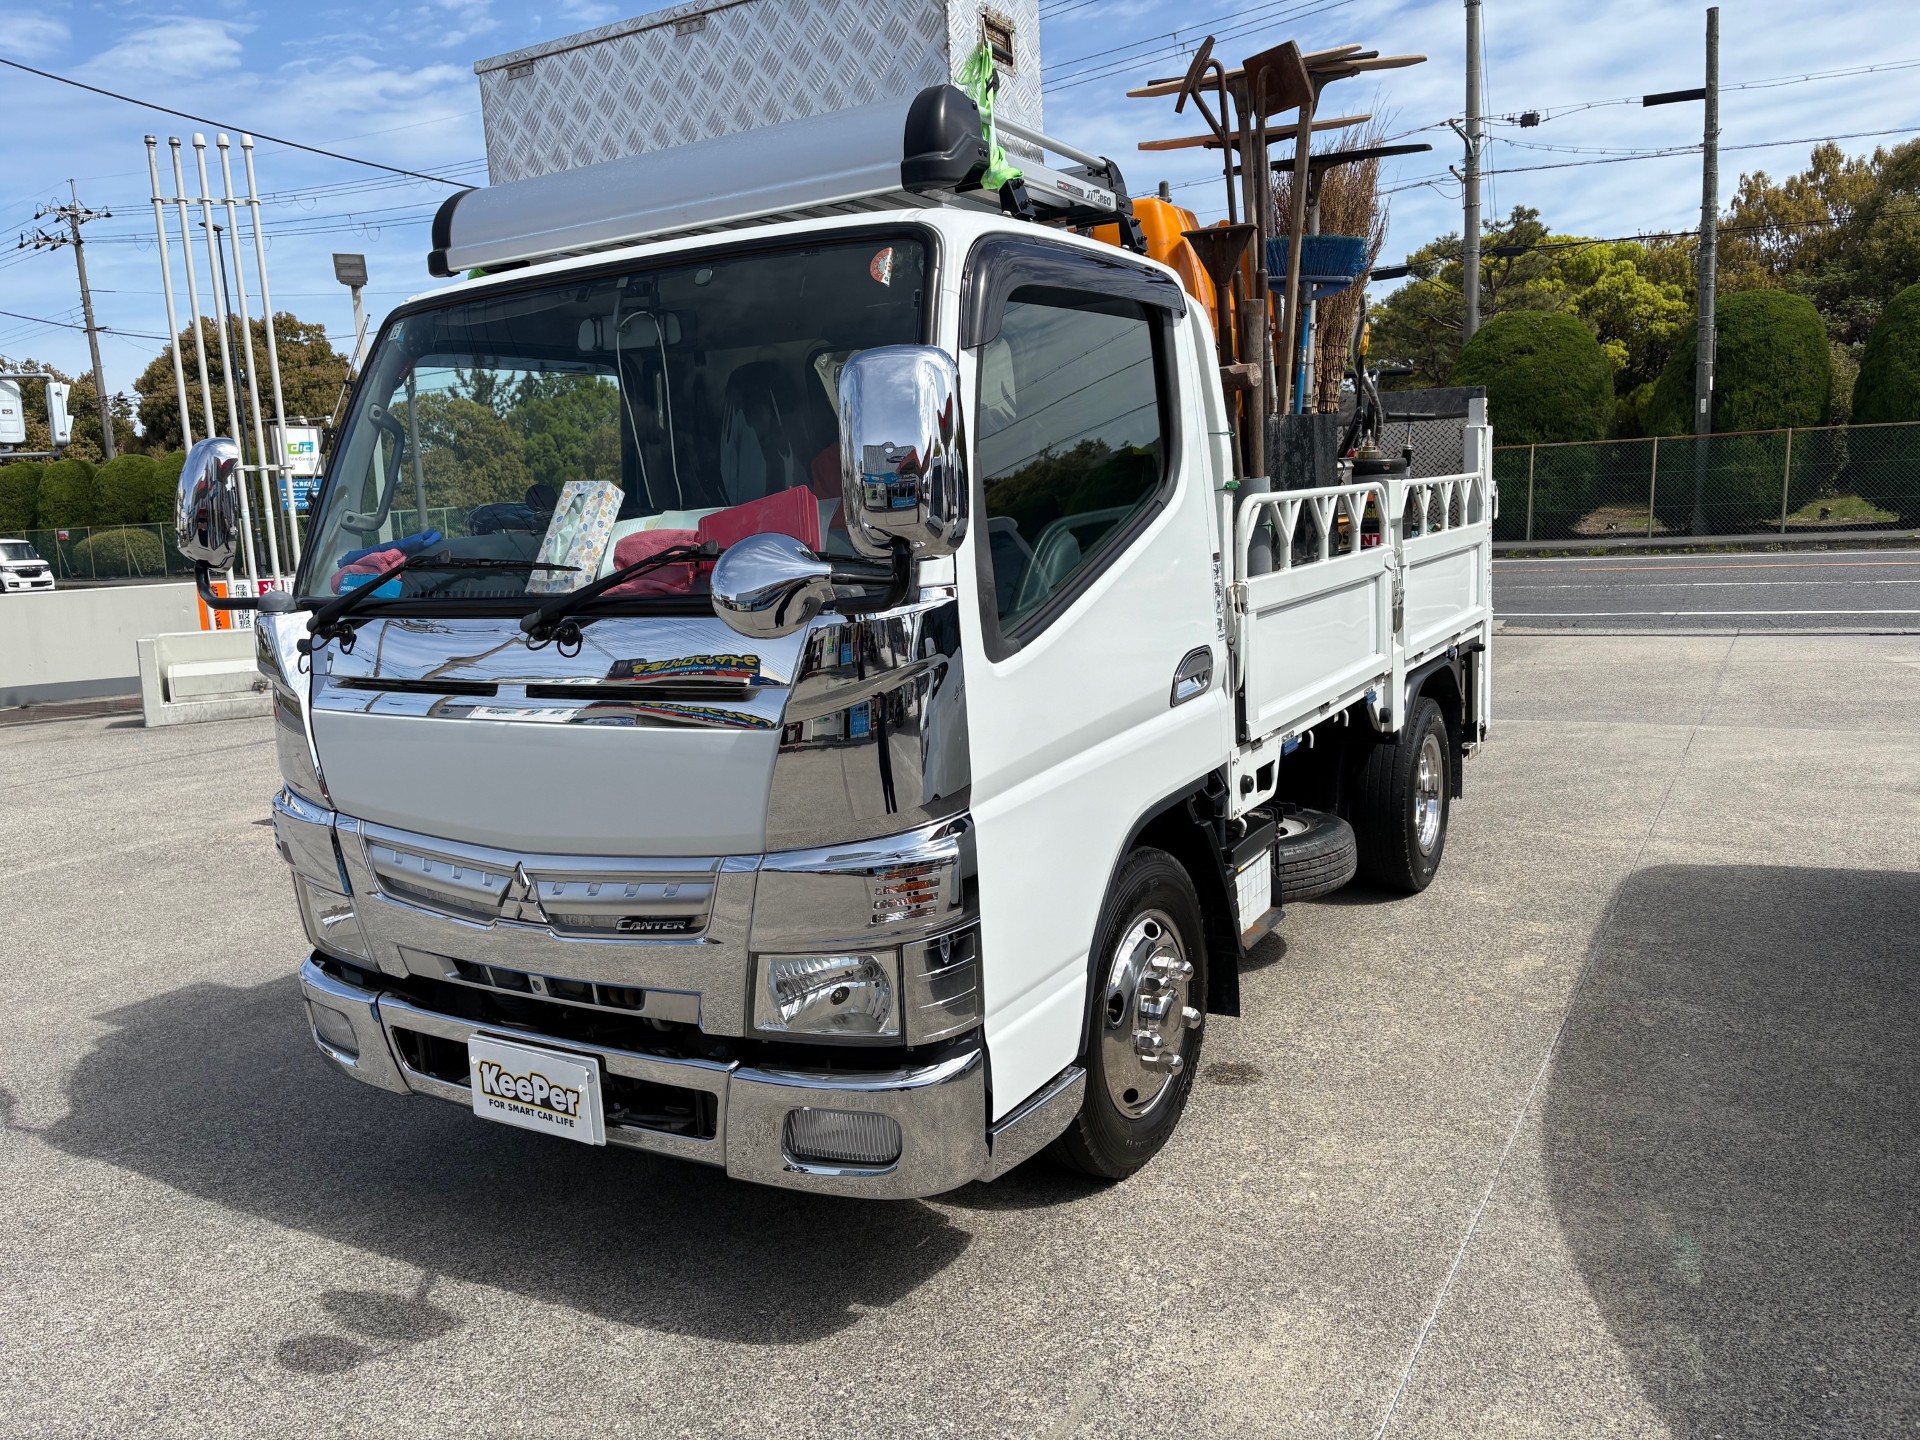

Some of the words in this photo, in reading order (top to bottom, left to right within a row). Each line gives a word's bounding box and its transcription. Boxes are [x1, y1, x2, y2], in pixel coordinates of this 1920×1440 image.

[616, 919, 686, 930] CANTER
[479, 1061, 580, 1118] KeePer
[488, 1098, 506, 1110] FOR
[508, 1102, 535, 1117] SMART
[537, 1110, 554, 1122] CAR
[555, 1116, 575, 1128] LIFE
